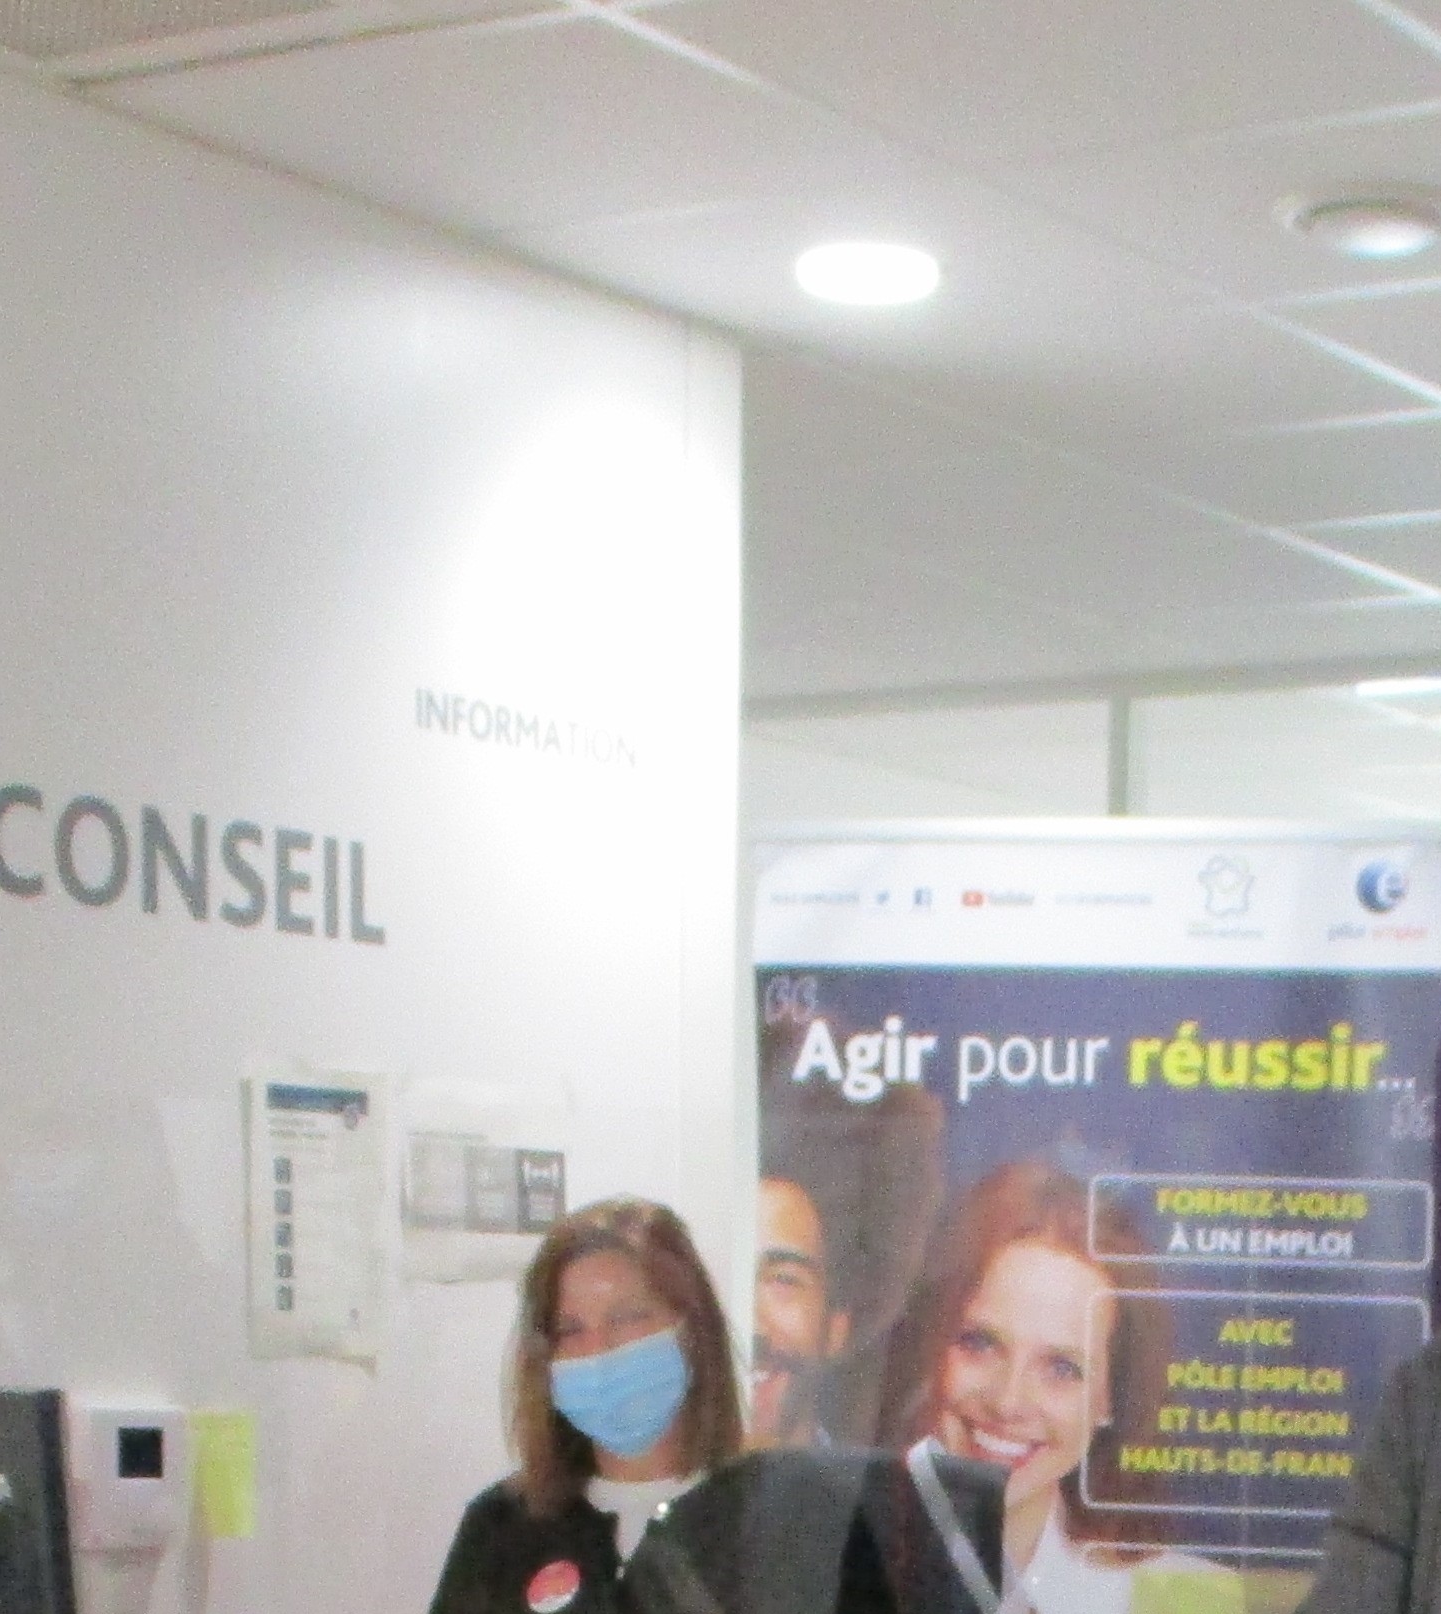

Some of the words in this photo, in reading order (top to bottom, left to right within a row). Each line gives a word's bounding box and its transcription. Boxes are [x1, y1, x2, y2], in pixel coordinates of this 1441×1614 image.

[415, 688, 636, 768] INFORMATION
[792, 1015, 939, 1102] Agir
[959, 1035, 1109, 1102] pour
[1156, 1187, 1369, 1220] FORMEZ-VOUS
[1195, 1228, 1242, 1253] UN
[1247, 1229, 1354, 1257] EMPLOI
[1218, 1318, 1295, 1346] AVEC
[1166, 1359, 1236, 1391] PÔLE
[1241, 1365, 1346, 1395] EMPLOI
[1159, 1406, 1192, 1433] ET
[1197, 1408, 1233, 1434] LA
[1239, 1403, 1352, 1437] RÉGION
[1120, 1445, 1354, 1479] HAUTS-DE-FRAN
